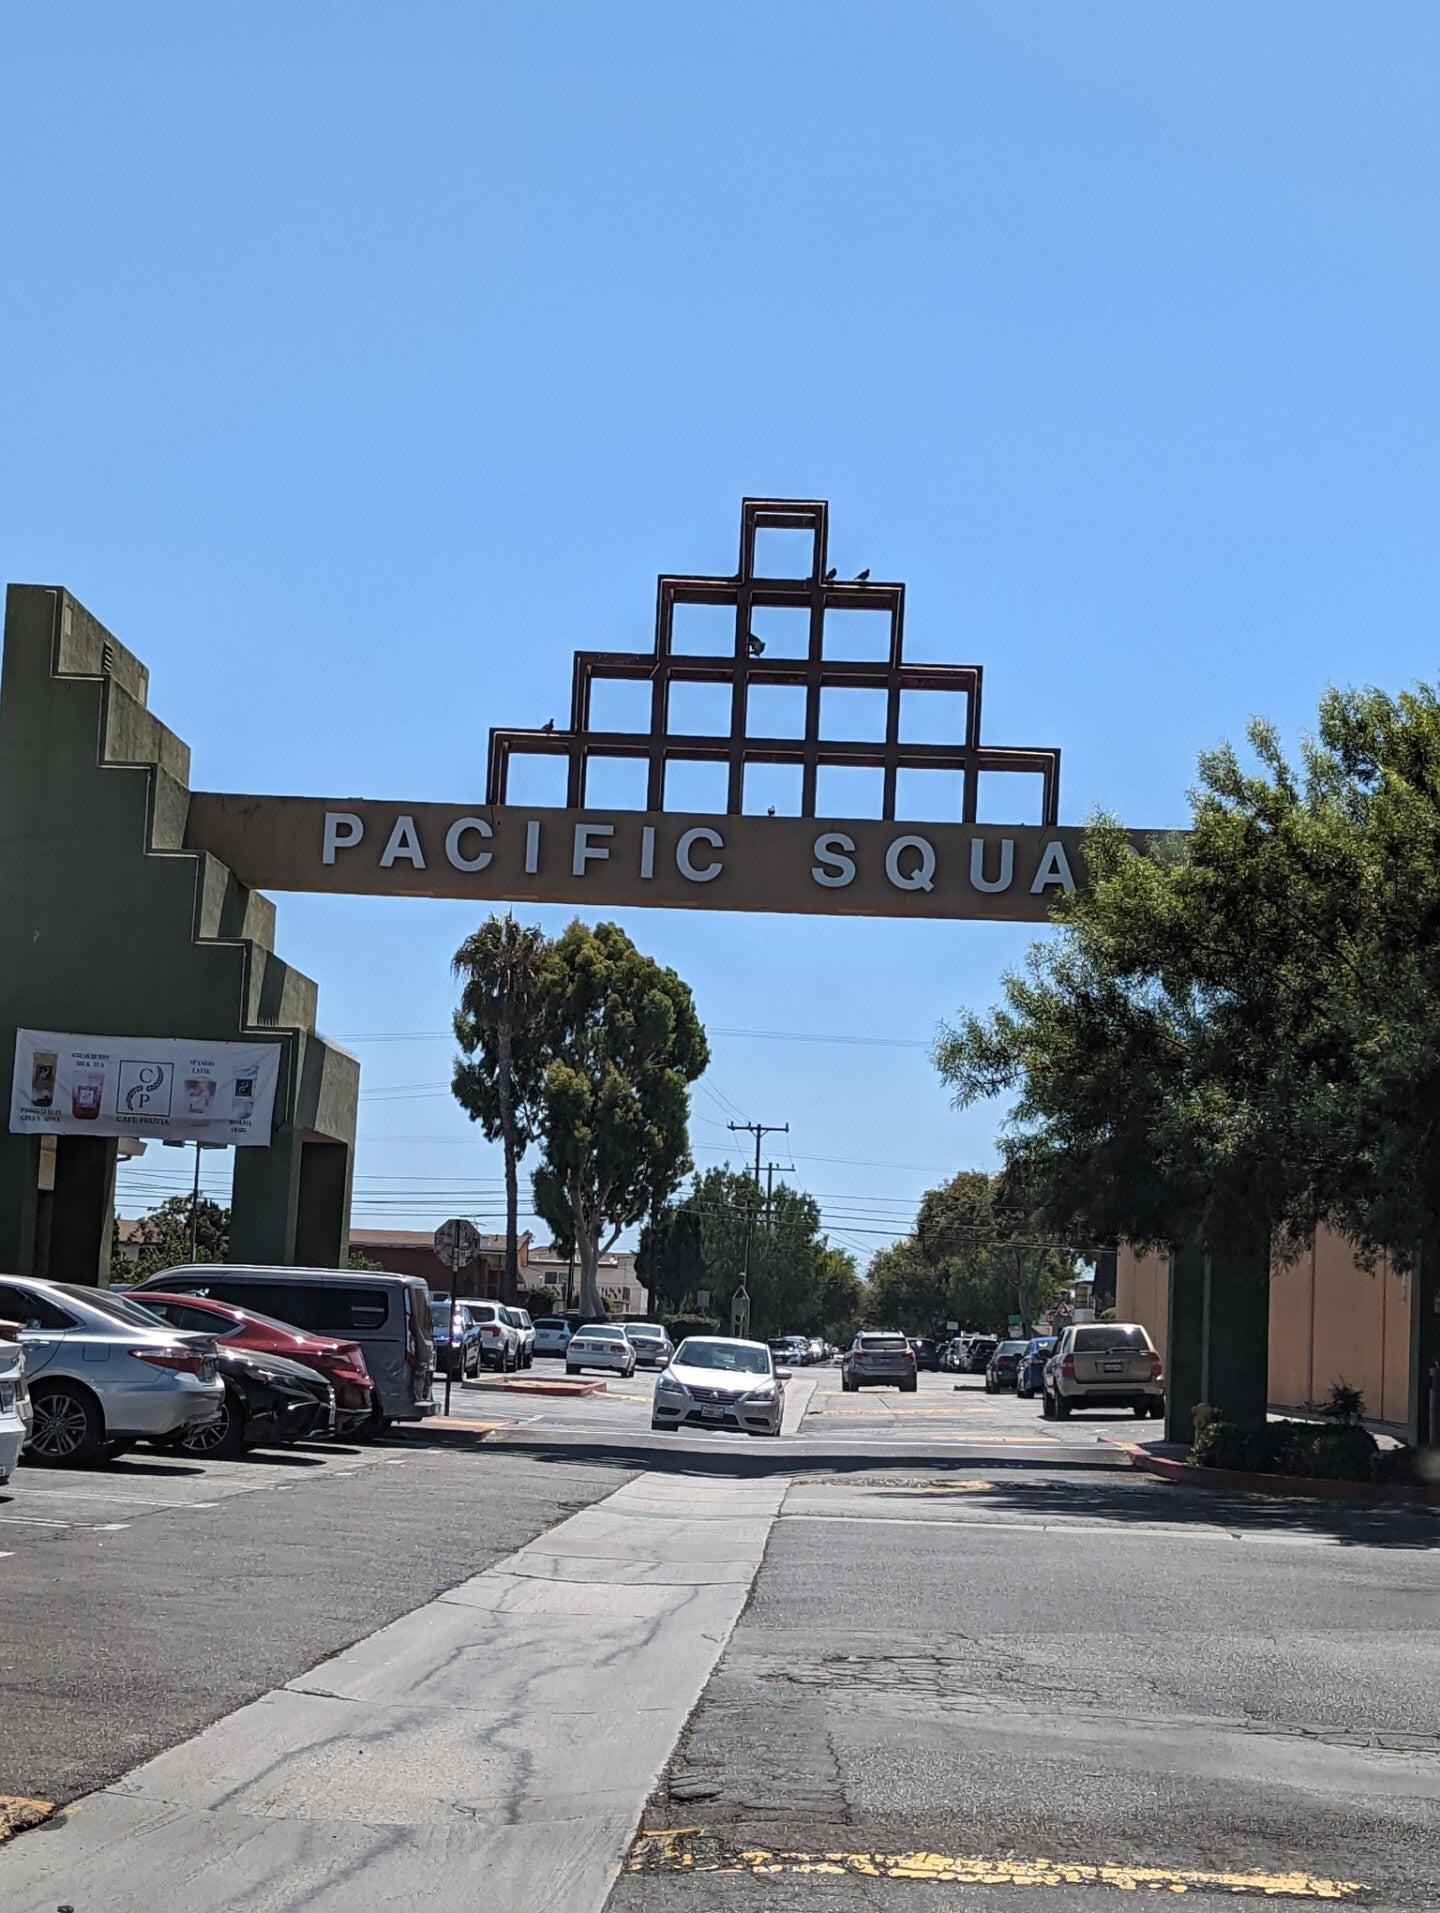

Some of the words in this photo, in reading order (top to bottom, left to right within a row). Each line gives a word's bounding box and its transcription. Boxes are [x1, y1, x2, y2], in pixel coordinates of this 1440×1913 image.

[321, 811, 725, 883] PACIFIC
[811, 832, 1139, 895] SQUA
[139, 1067, 153, 1083] C
[139, 1093, 150, 1108] P
